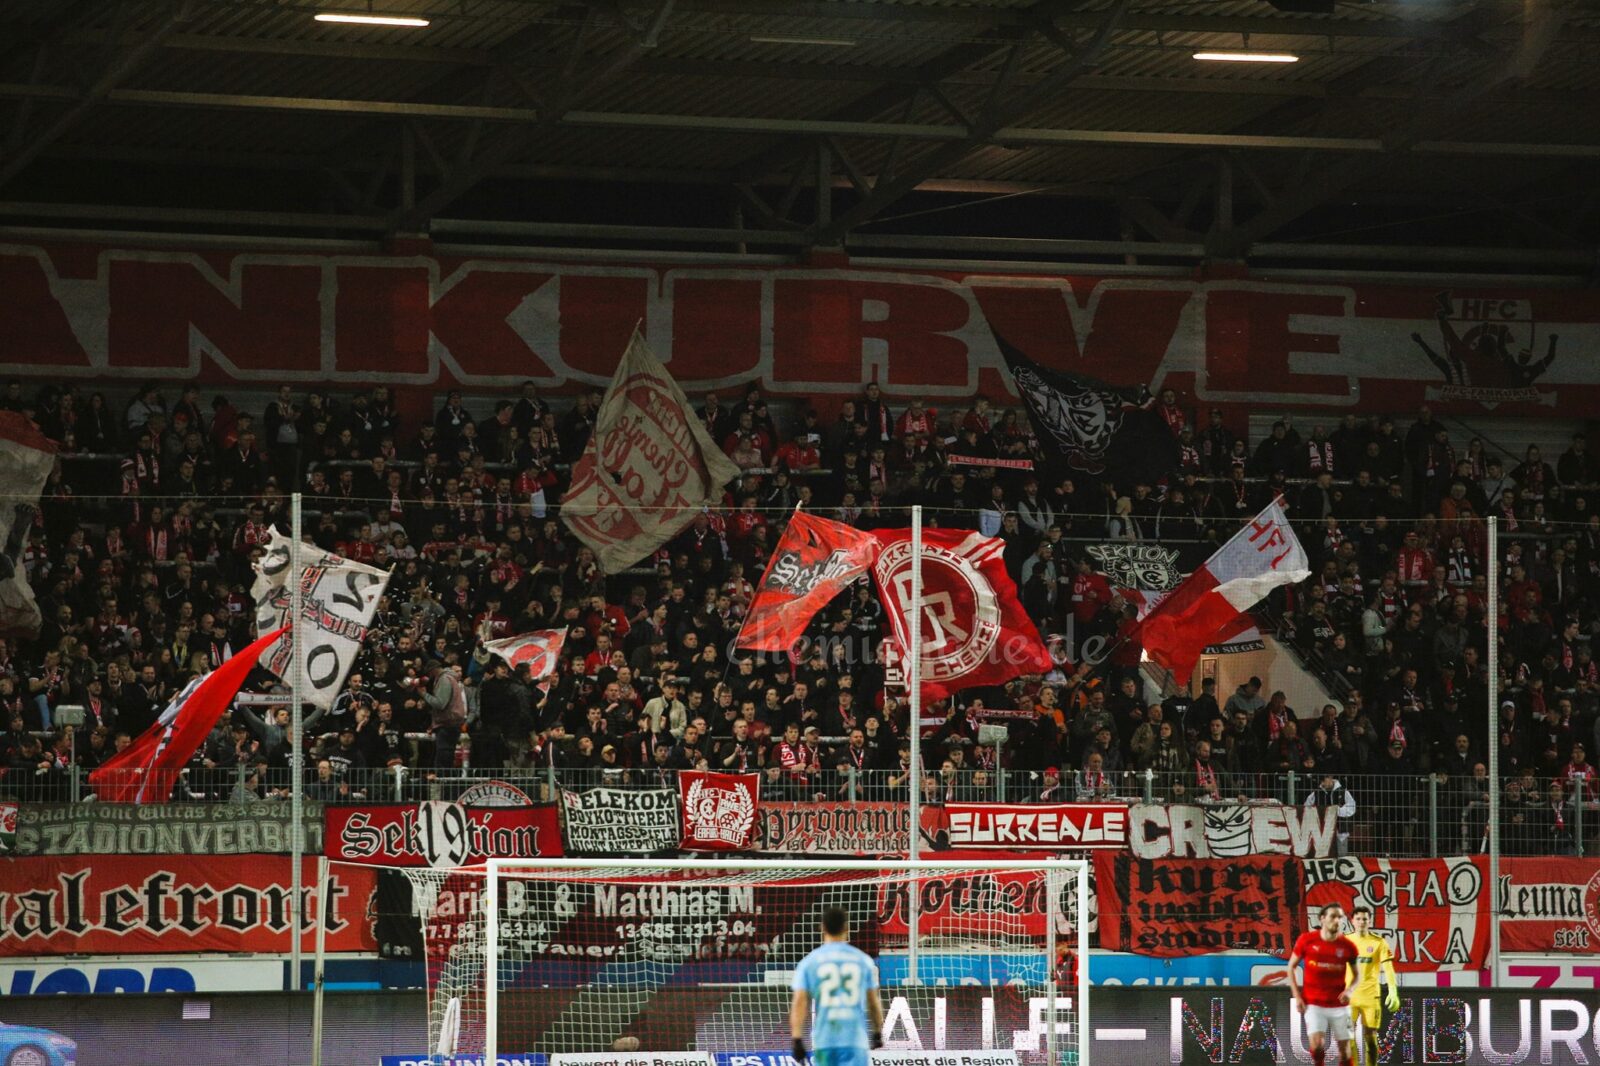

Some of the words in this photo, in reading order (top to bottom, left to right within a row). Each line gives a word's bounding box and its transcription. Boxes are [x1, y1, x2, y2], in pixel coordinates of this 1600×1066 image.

[950, 812, 1125, 843] SURREALE
[1499, 874, 1584, 919] Leuna
[1554, 925, 1589, 948] seit
[816, 962, 862, 1007] 23
